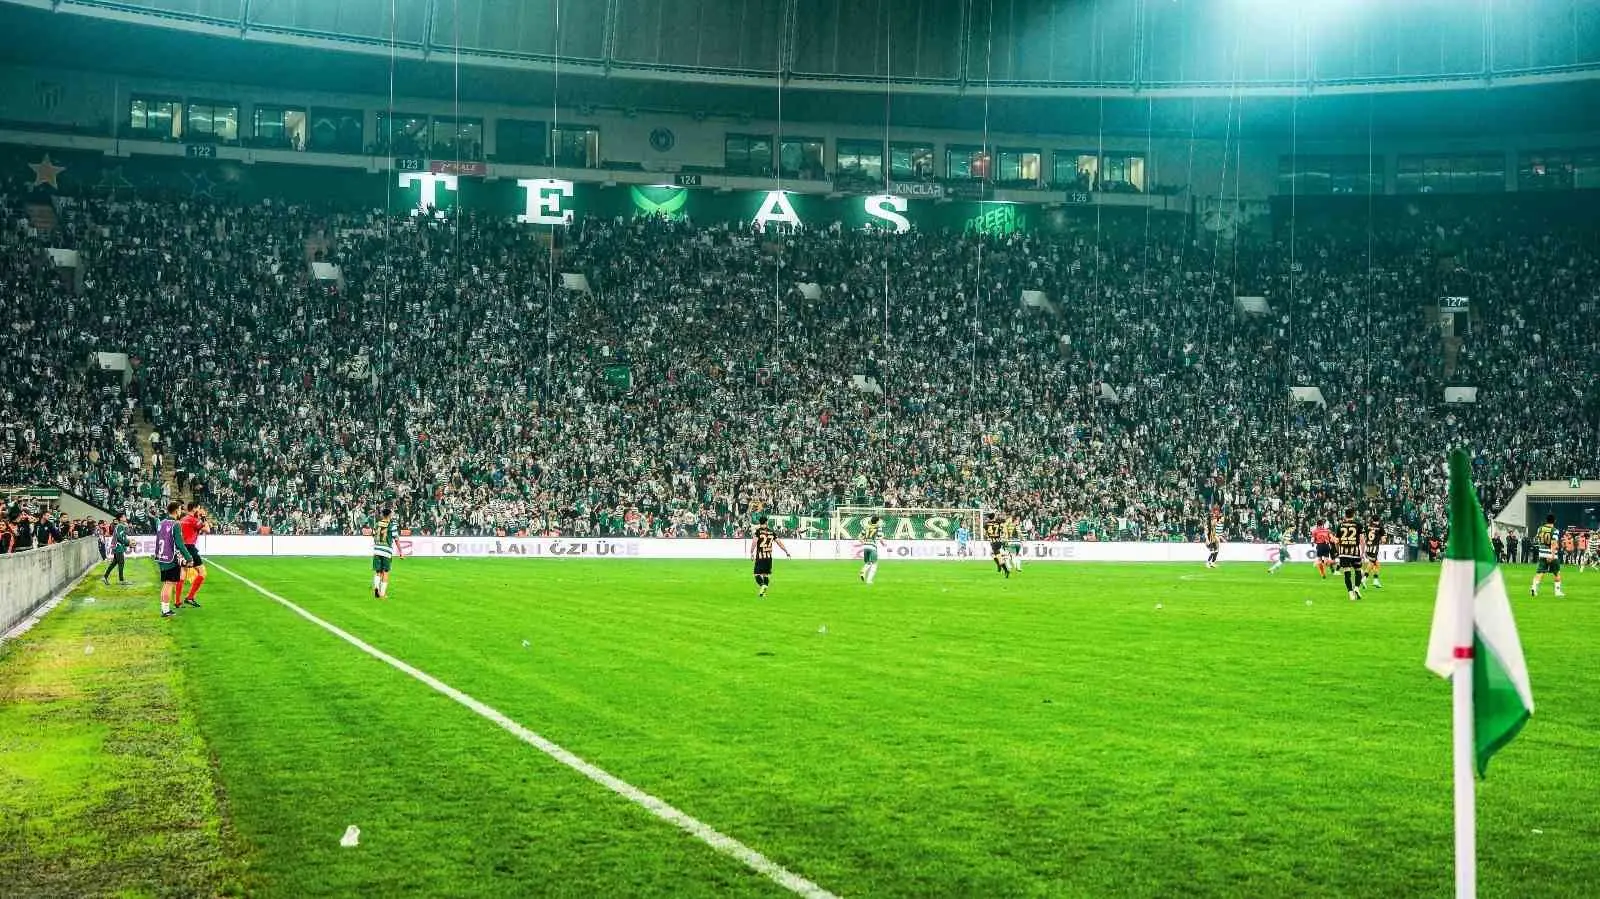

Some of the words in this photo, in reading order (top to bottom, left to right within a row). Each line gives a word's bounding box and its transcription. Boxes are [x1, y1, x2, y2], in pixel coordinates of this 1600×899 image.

[192, 146, 210, 156] 122
[402, 160, 418, 168] 123
[680, 175, 696, 184] 124
[1446, 296, 1462, 307] 127
[1571, 477, 1579, 488] A
[1340, 527, 1357, 541] 22
[1368, 529, 1375, 541] 6
